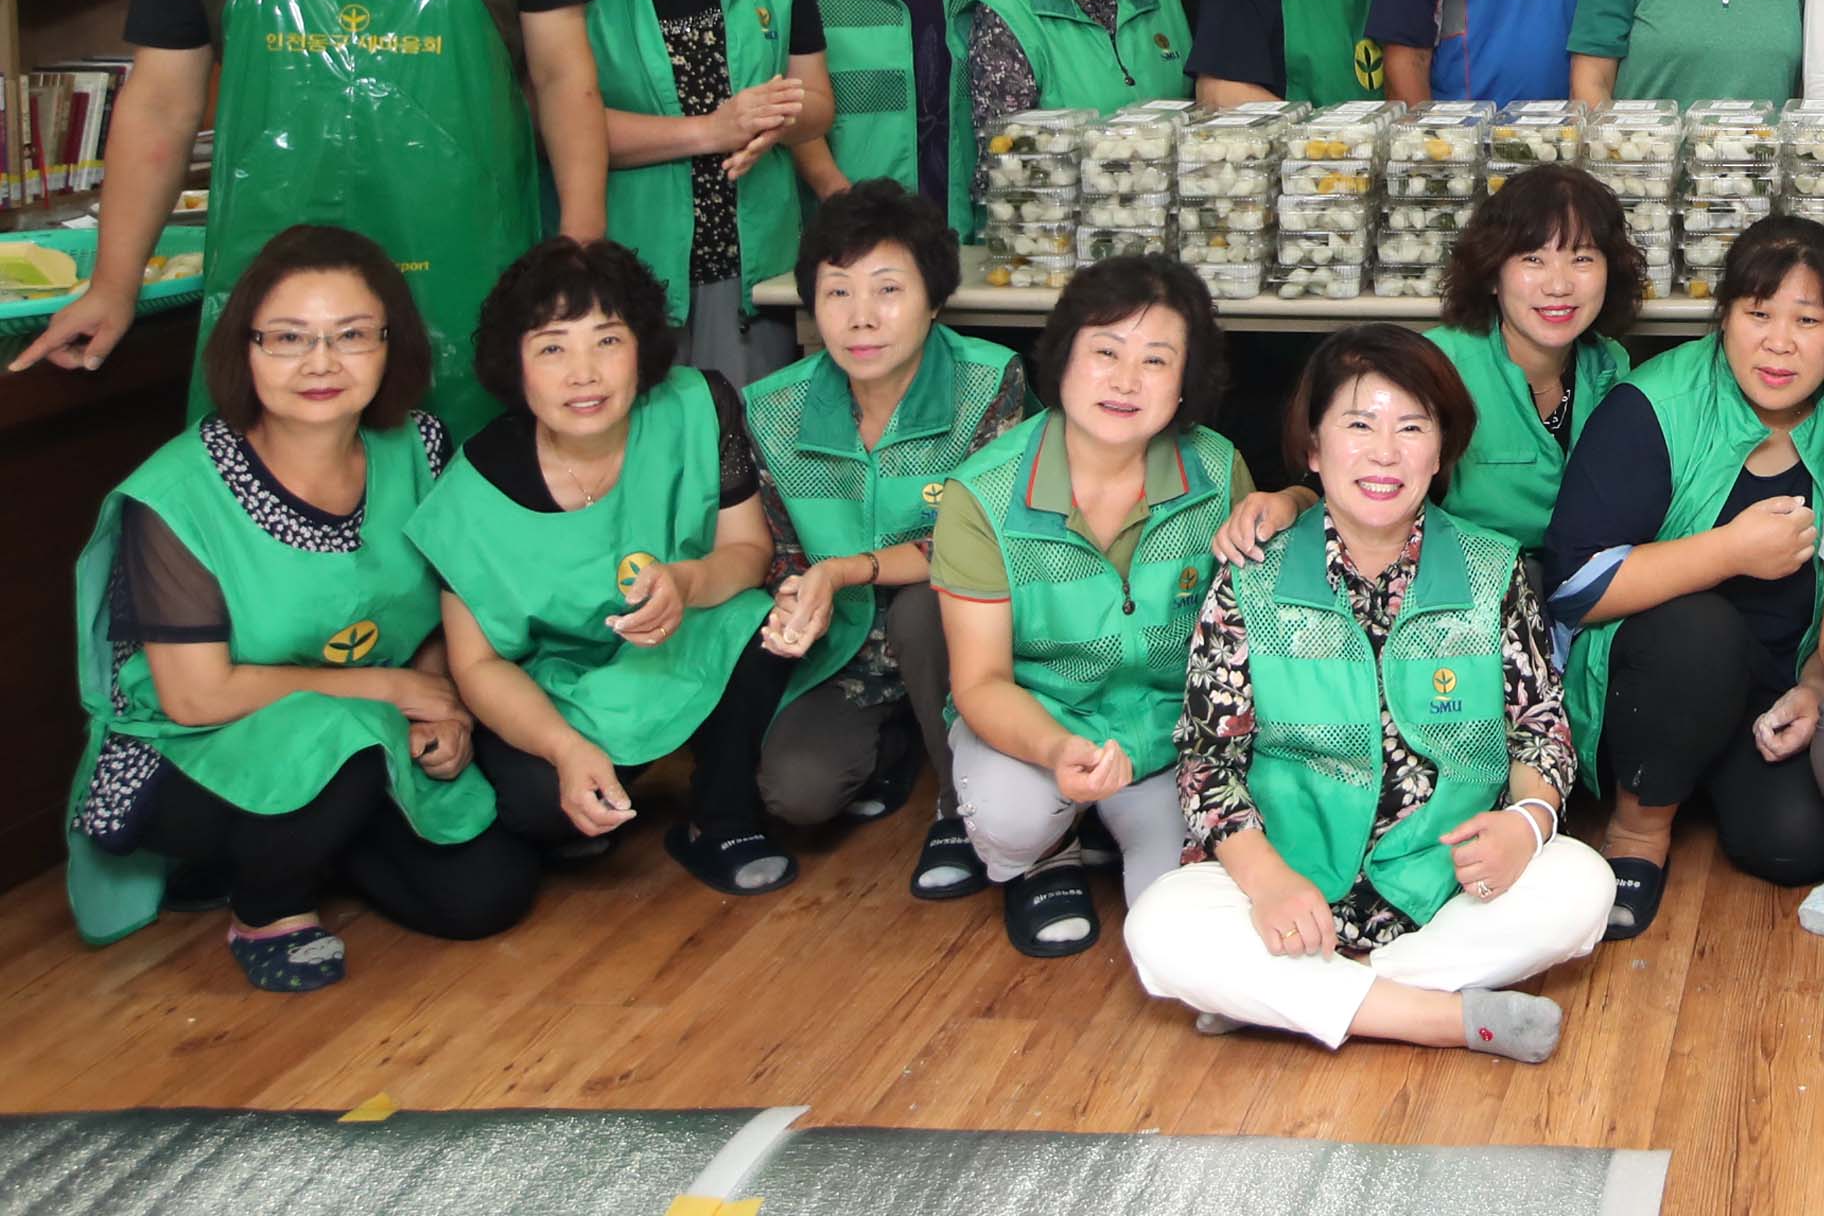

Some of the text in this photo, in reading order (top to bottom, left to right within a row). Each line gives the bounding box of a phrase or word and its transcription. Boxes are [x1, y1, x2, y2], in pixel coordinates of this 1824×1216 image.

[920, 509, 938, 521] SM
[1174, 593, 1198, 608] SMU
[1430, 699, 1462, 714] SMU
